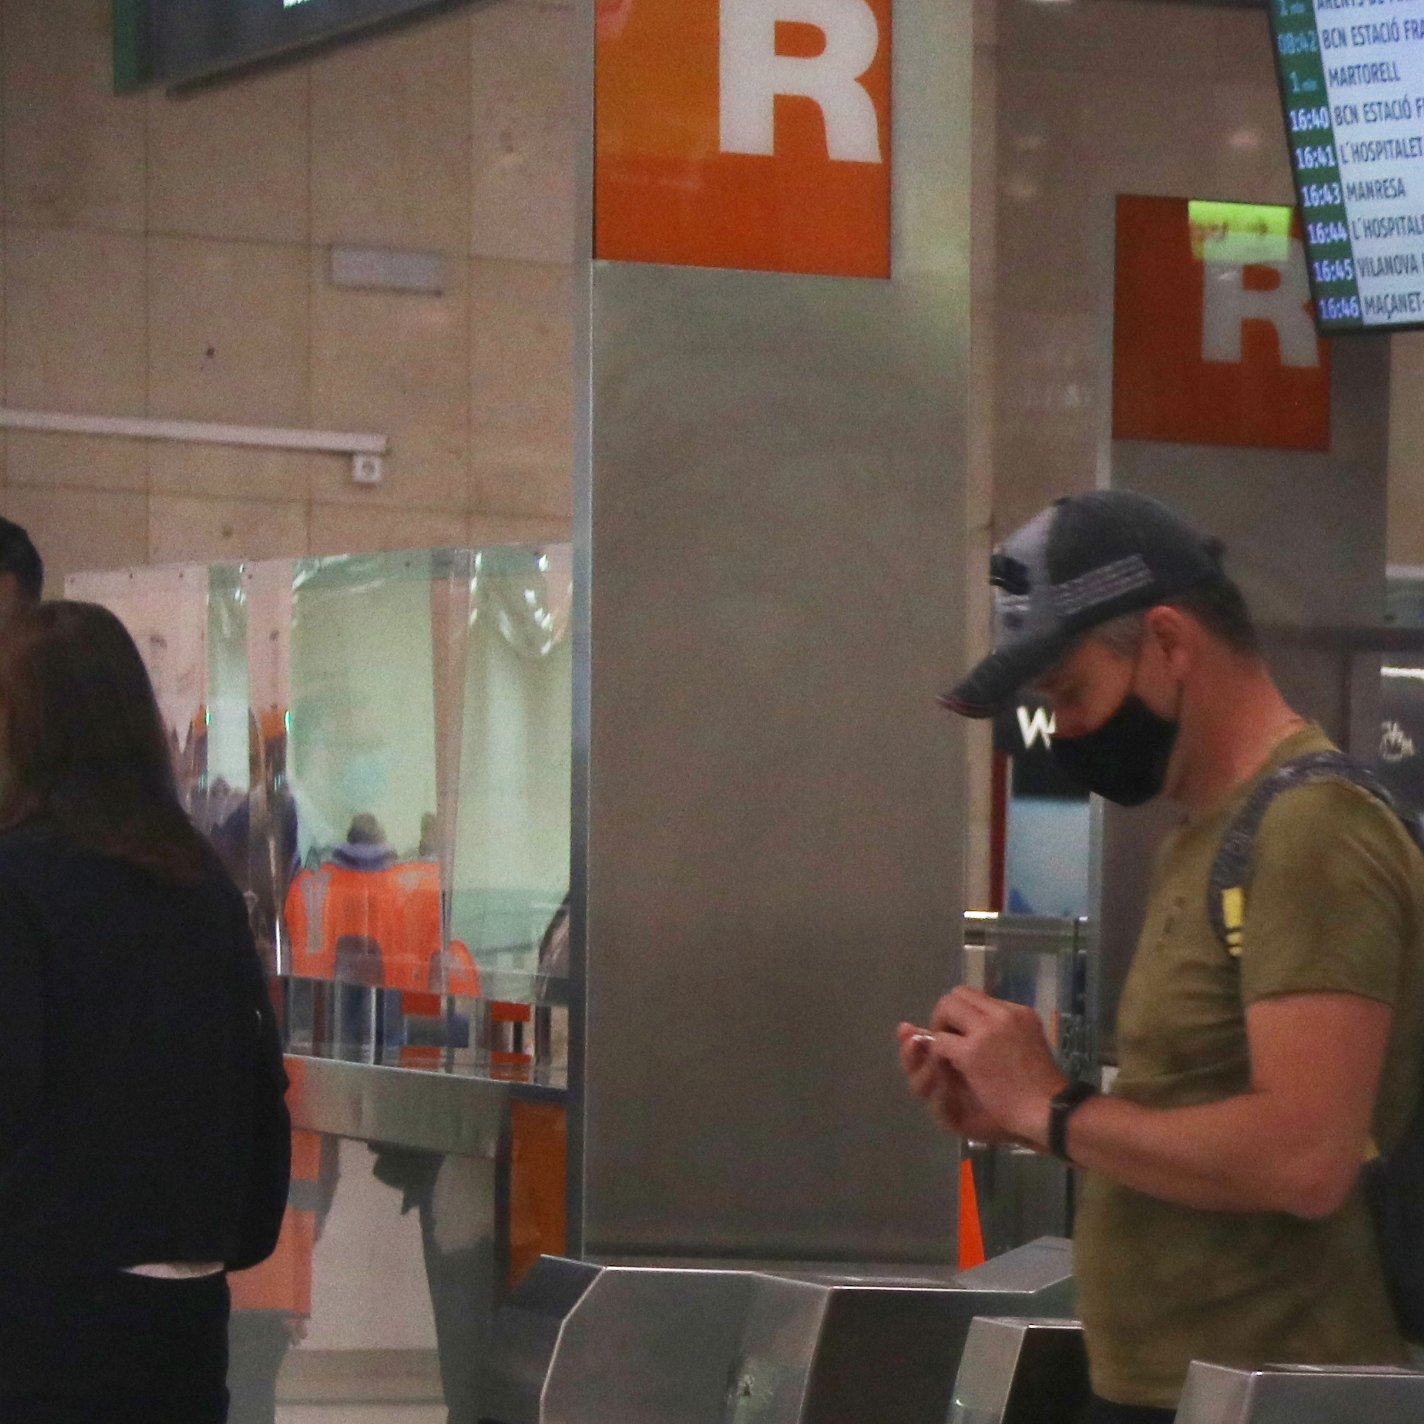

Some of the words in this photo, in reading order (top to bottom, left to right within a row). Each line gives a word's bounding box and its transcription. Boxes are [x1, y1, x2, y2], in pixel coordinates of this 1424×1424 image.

[1322, 27, 1347, 50] BCN
[1351, 16, 1400, 46] ESTACIÓ
[718, 0, 883, 164] R
[1328, 61, 1400, 87] MARTORELL
[1290, 106, 1330, 131] 16:40
[1335, 104, 1359, 126] BCN
[1363, 94, 1412, 123] ESTACIÓ
[1296, 145, 1336, 169] 16:41
[1346, 177, 1406, 201] MANRESA
[1307, 222, 1348, 246] 16:44
[1313, 259, 1353, 283] 16:45
[1356, 251, 1418, 278] VILANOVA
[1319, 295, 1360, 320] 16:46
